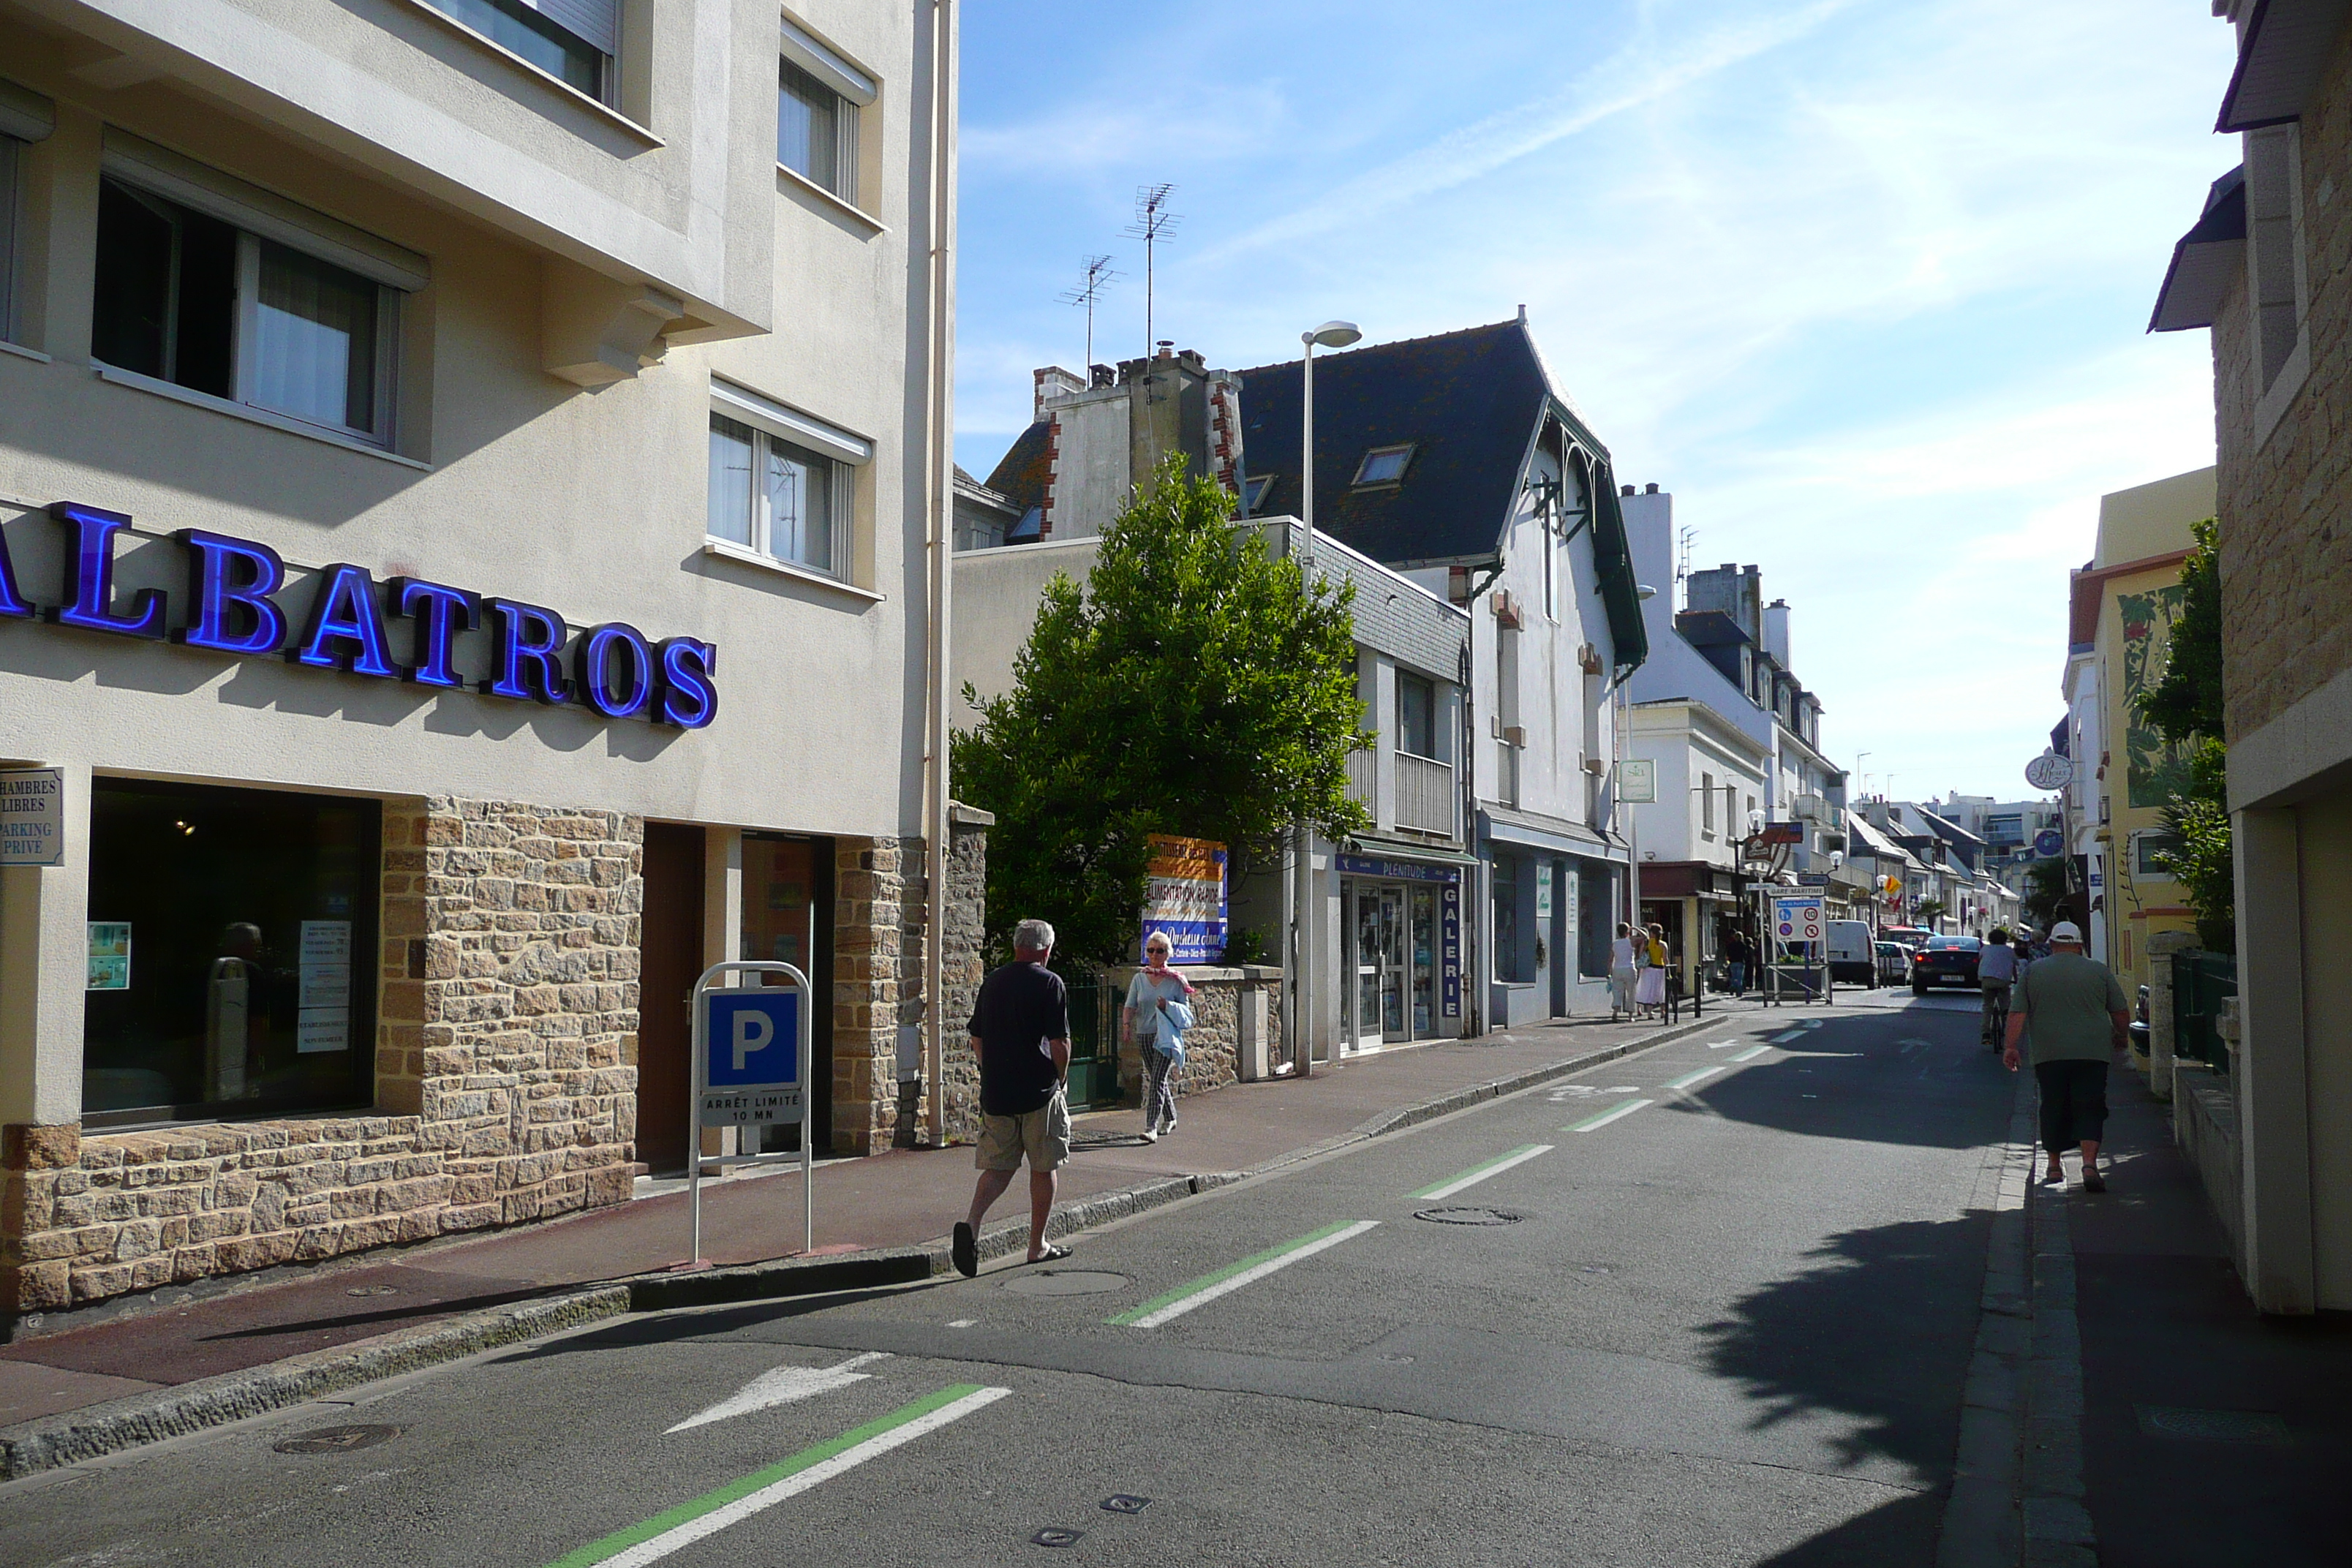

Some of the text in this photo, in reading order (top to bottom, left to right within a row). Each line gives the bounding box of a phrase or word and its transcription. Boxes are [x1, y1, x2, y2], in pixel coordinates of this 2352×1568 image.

[0, 500, 718, 731] LBATROS
[0, 780, 56, 794] HAMBRES
[2, 798, 45, 812] LIBRES
[1166, 926, 1200, 946] Duchesse
[1444, 889, 1457, 1015] GALERIE
[733, 1010, 774, 1069] P
[706, 1095, 799, 1109] ARRÊT LIMITÉ
[733, 1110, 772, 1120] 10 MN
